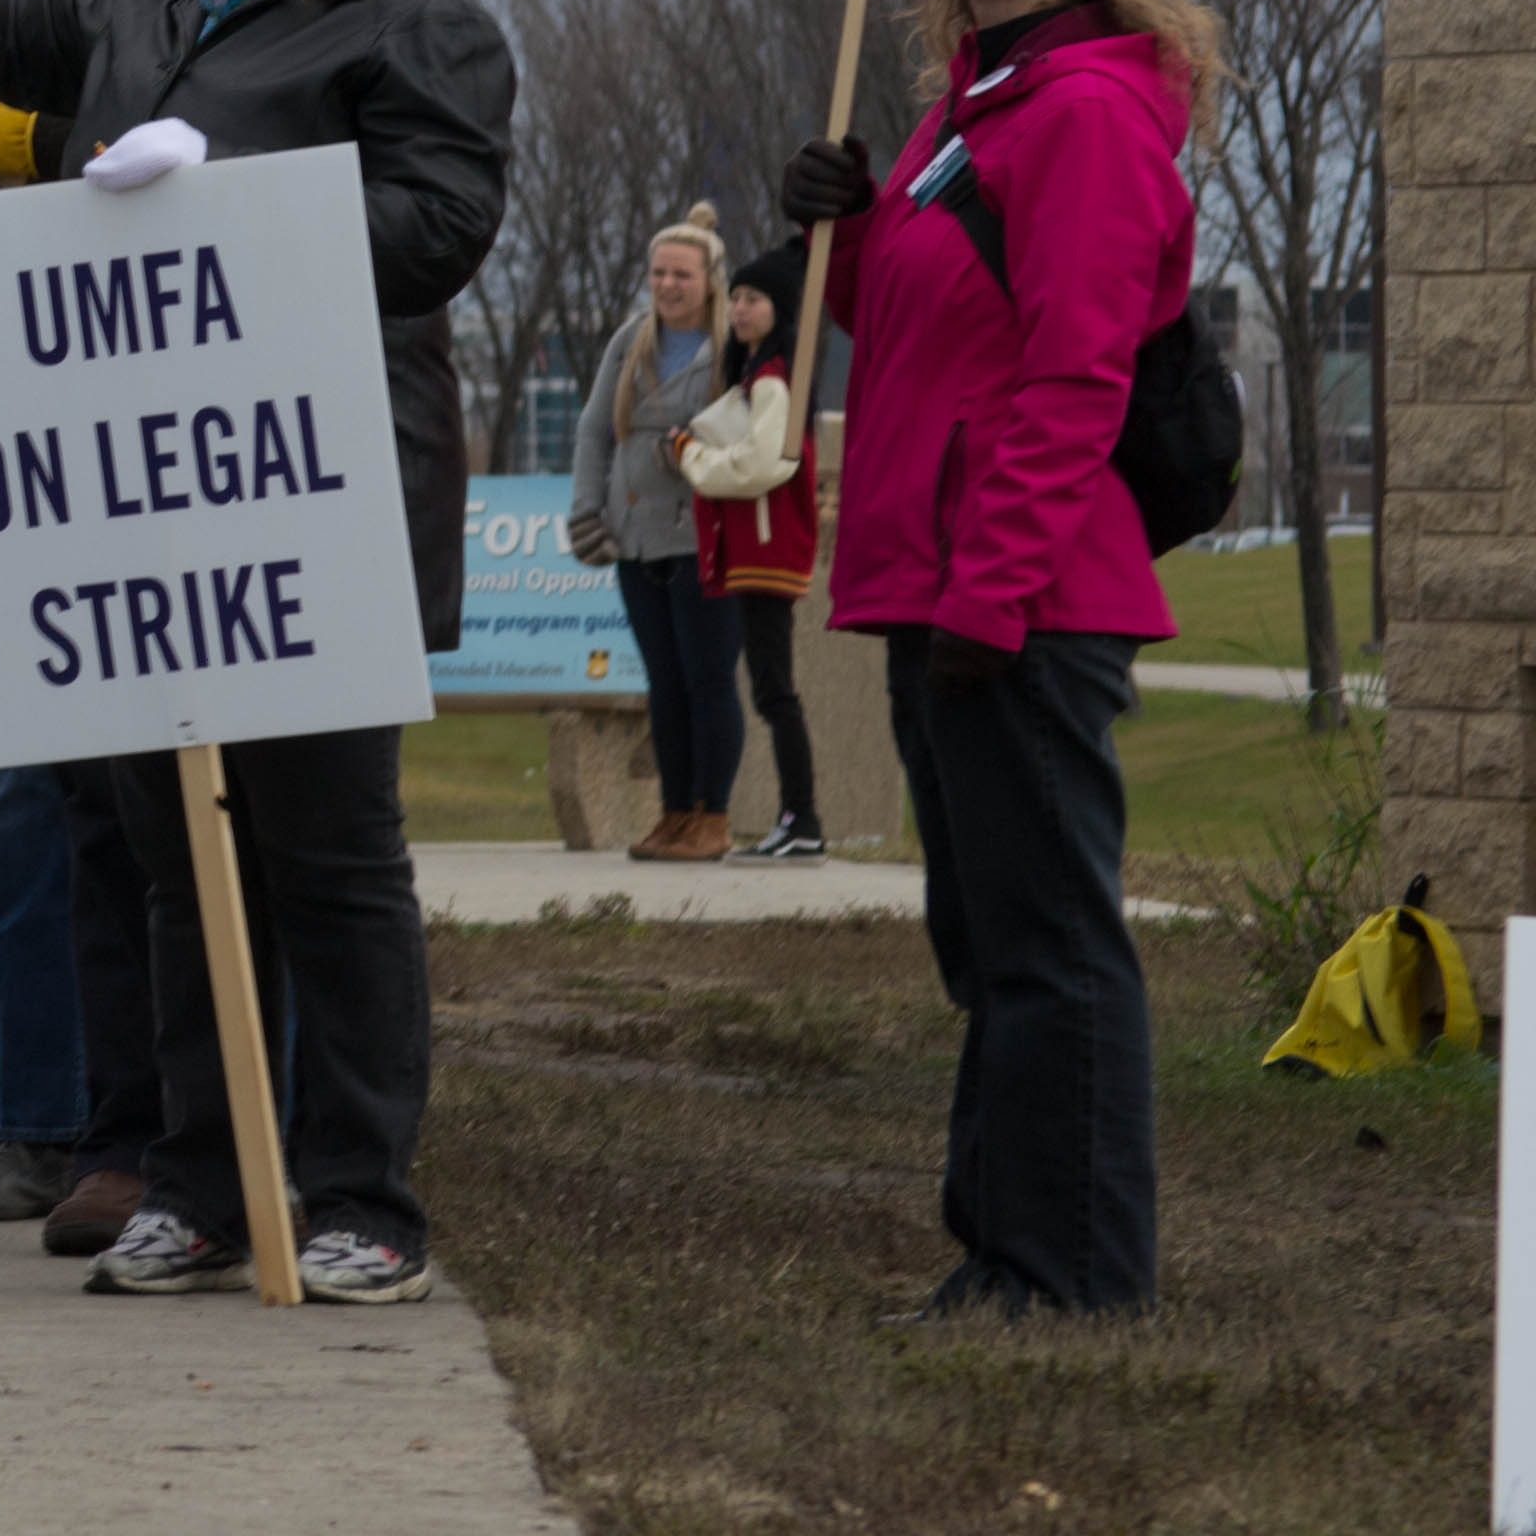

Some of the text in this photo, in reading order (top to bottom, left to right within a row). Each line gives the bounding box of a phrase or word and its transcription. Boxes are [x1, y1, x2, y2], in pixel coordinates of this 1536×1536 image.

[17, 244, 243, 367] UMFA
[94, 395, 345, 519] LEGAL
[32, 558, 316, 687] STRIKE
[493, 615, 578, 637] program
[525, 566, 616, 597] Opport
